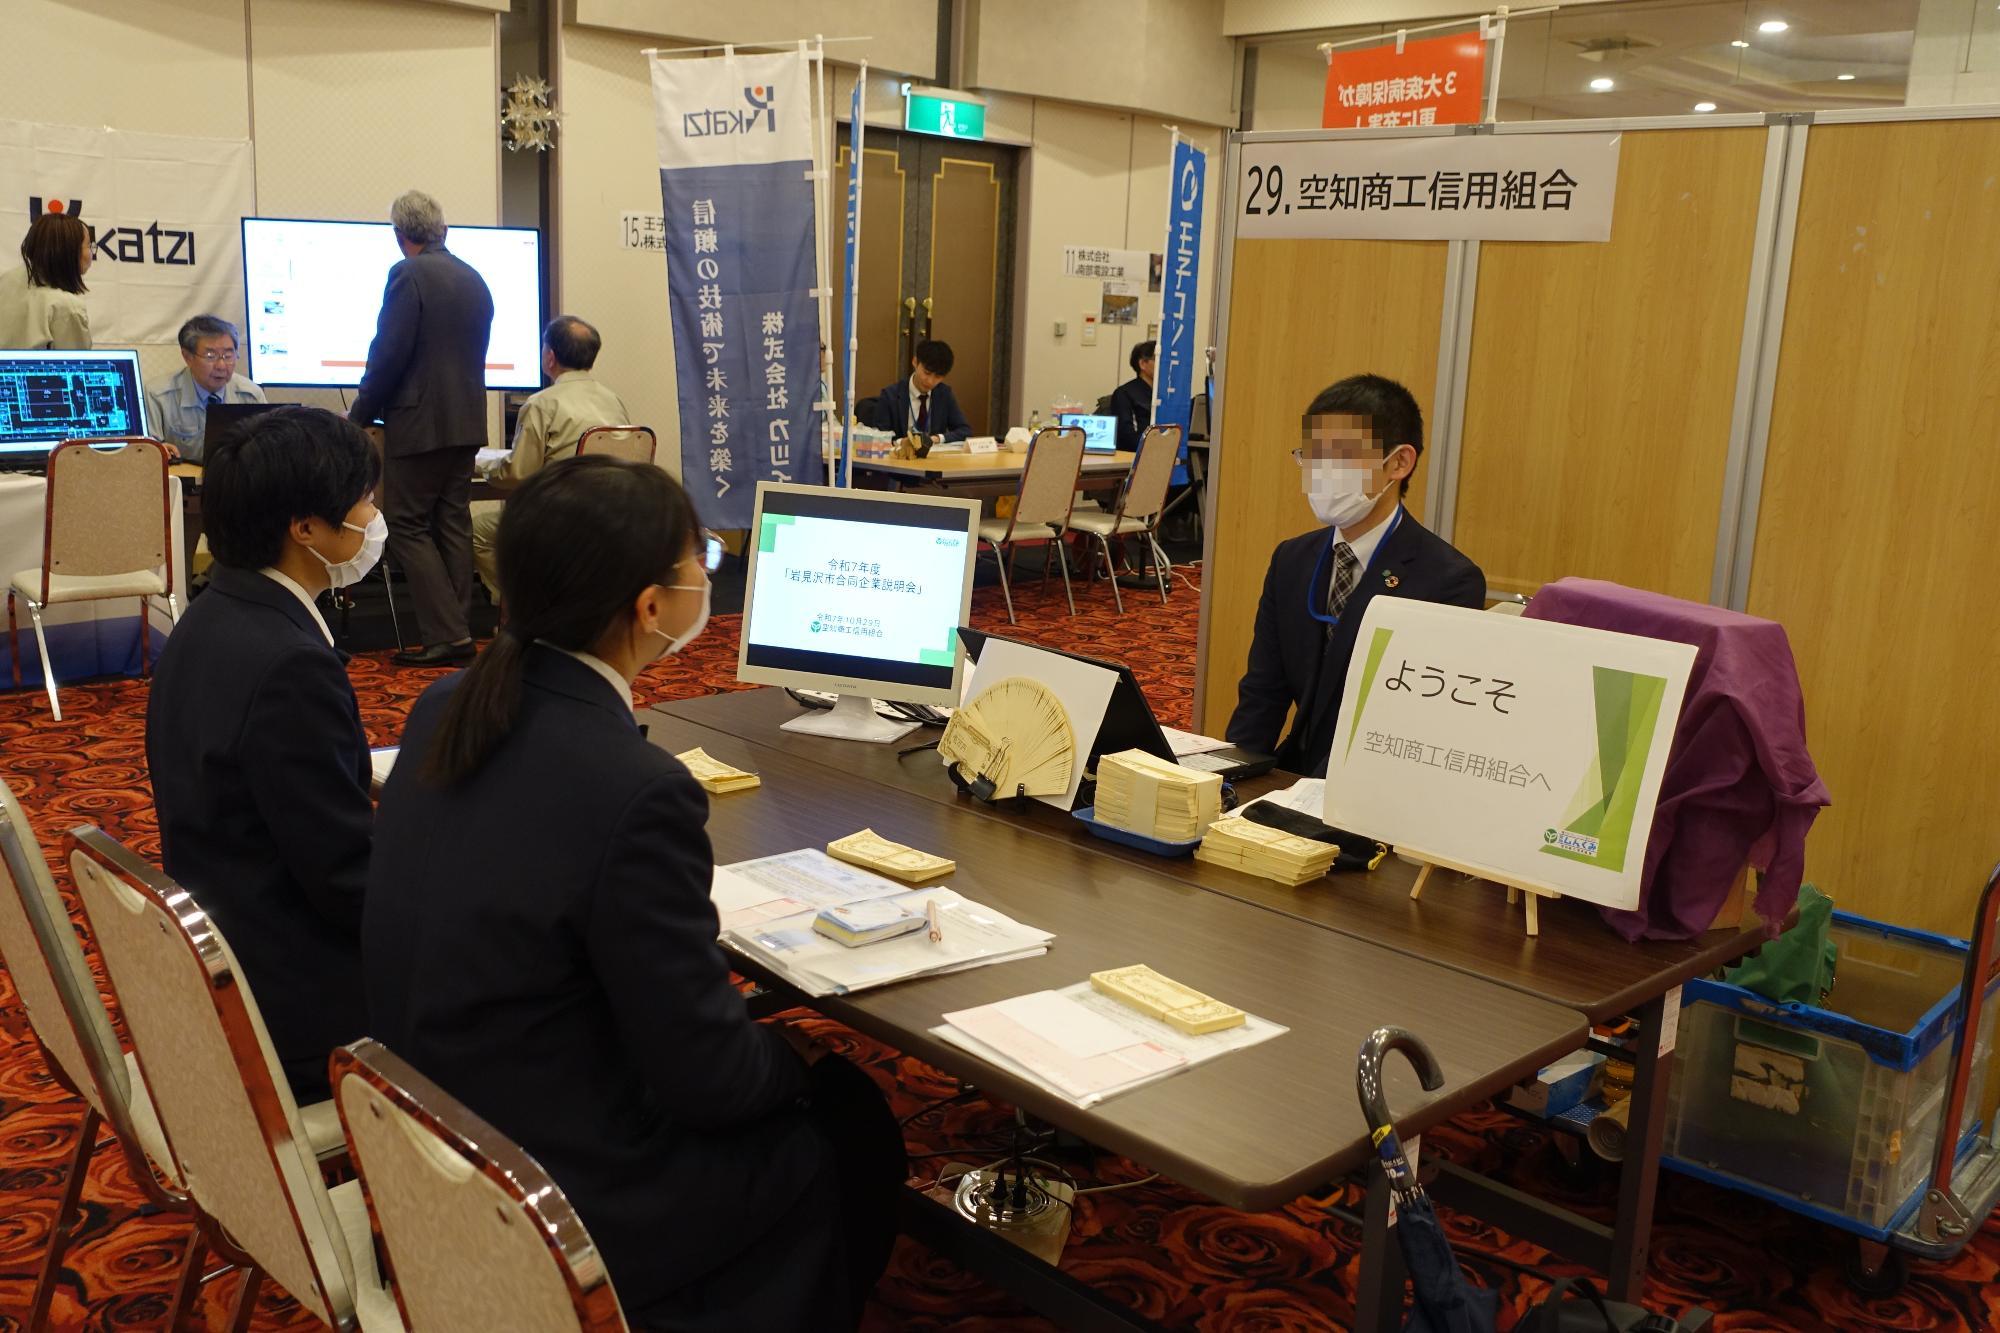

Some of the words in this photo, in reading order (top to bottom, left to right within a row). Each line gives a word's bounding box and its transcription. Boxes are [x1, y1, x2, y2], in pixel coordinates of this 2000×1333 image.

[1078, 249, 1110, 263] 株式会社
[827, 557, 881, 576] 令和7年度
[784, 567, 923, 596] 「岩見沢市合同企業説明会」
[1385, 659, 1517, 715] ようこそ
[1363, 730, 1552, 792] 空知商工信用組合へ
